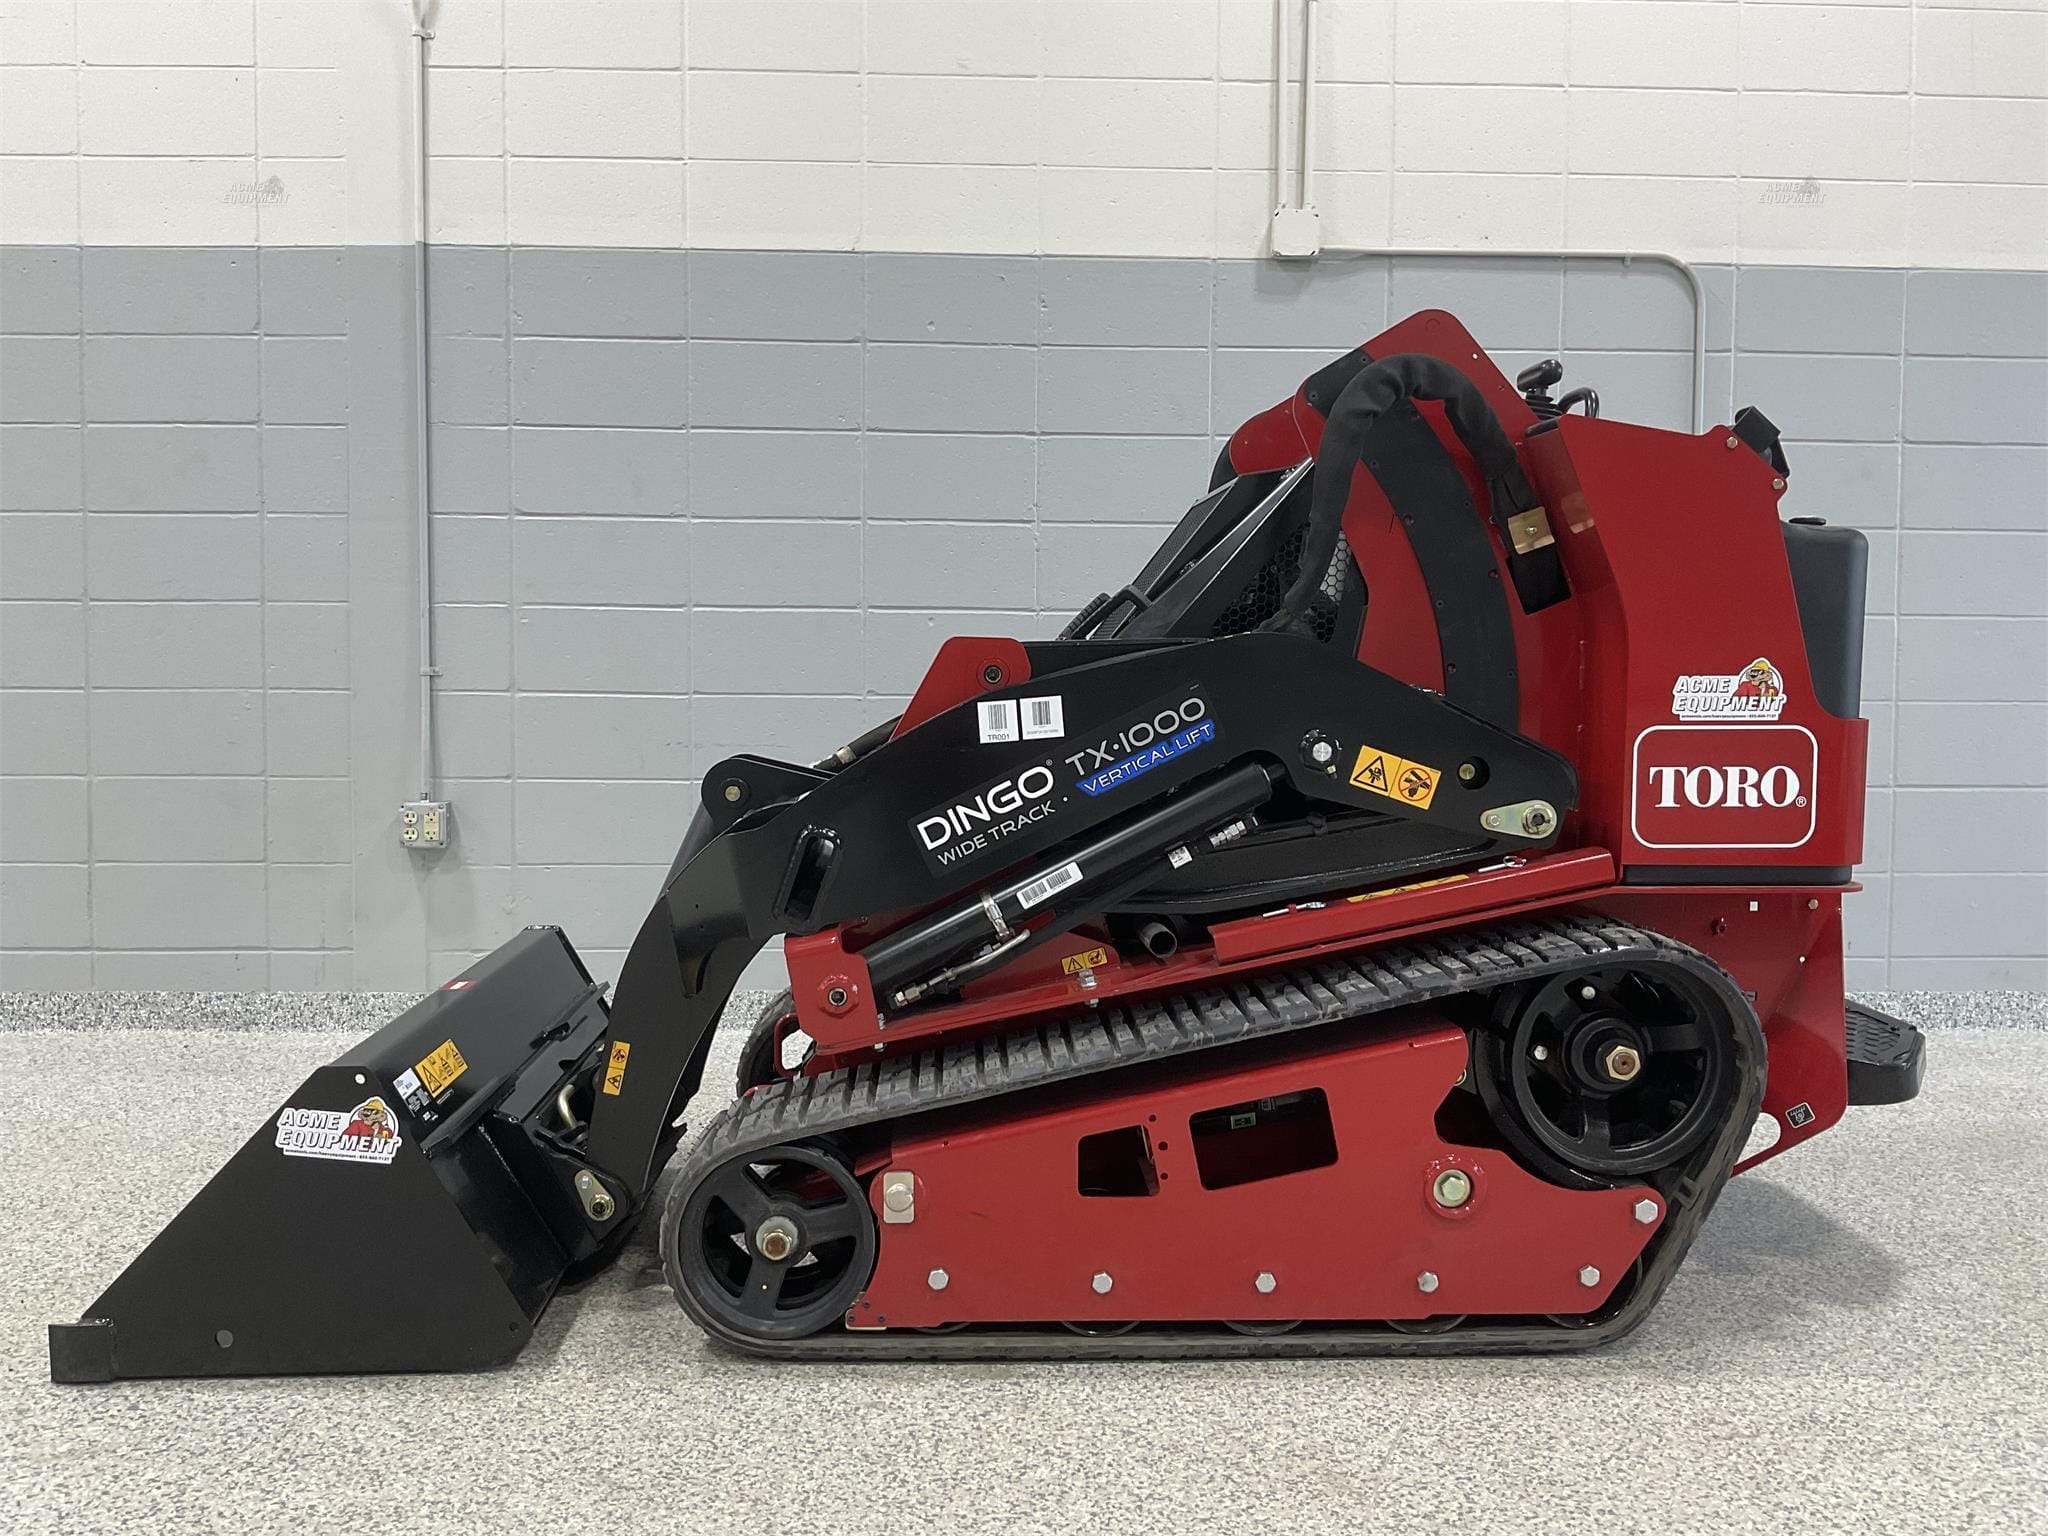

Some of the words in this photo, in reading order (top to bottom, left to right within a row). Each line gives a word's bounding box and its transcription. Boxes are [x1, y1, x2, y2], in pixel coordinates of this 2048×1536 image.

[1676, 677, 1731, 694] ACME
[1675, 695, 1785, 713] EQUIPMENT
[1085, 746, 1175, 792] VERTICAL
[1176, 724, 1212, 753] LIFT
[938, 833, 987, 866] WIDE
[988, 800, 1057, 841] TRACK
[280, 1109, 341, 1131] ACME
[279, 1128, 399, 1155] EQUIPMENT
